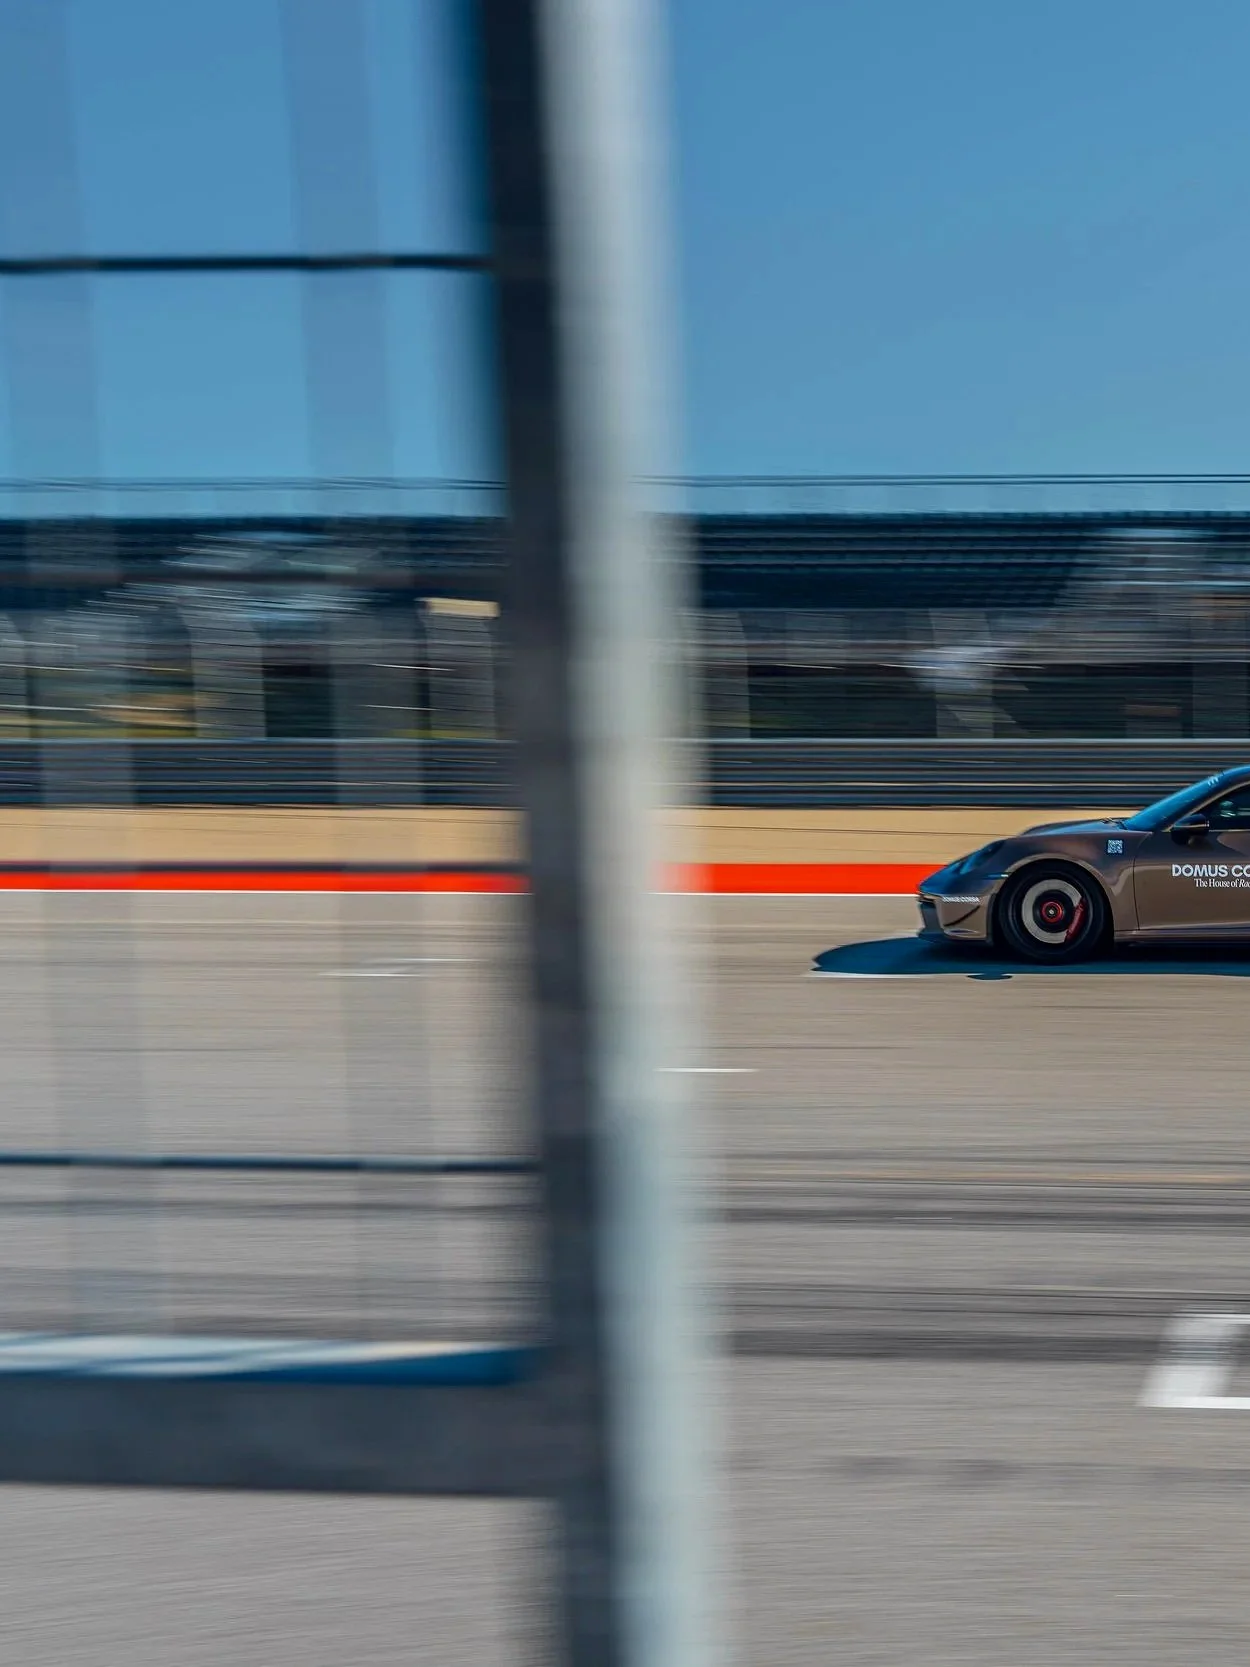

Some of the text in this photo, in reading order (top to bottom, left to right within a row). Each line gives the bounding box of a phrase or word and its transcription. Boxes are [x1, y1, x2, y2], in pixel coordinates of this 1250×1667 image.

[1171, 864, 1228, 877] DOMUS
[1194, 878, 1208, 888] The
[1209, 878, 1230, 888] House
[1230, 878, 1239, 888] of
